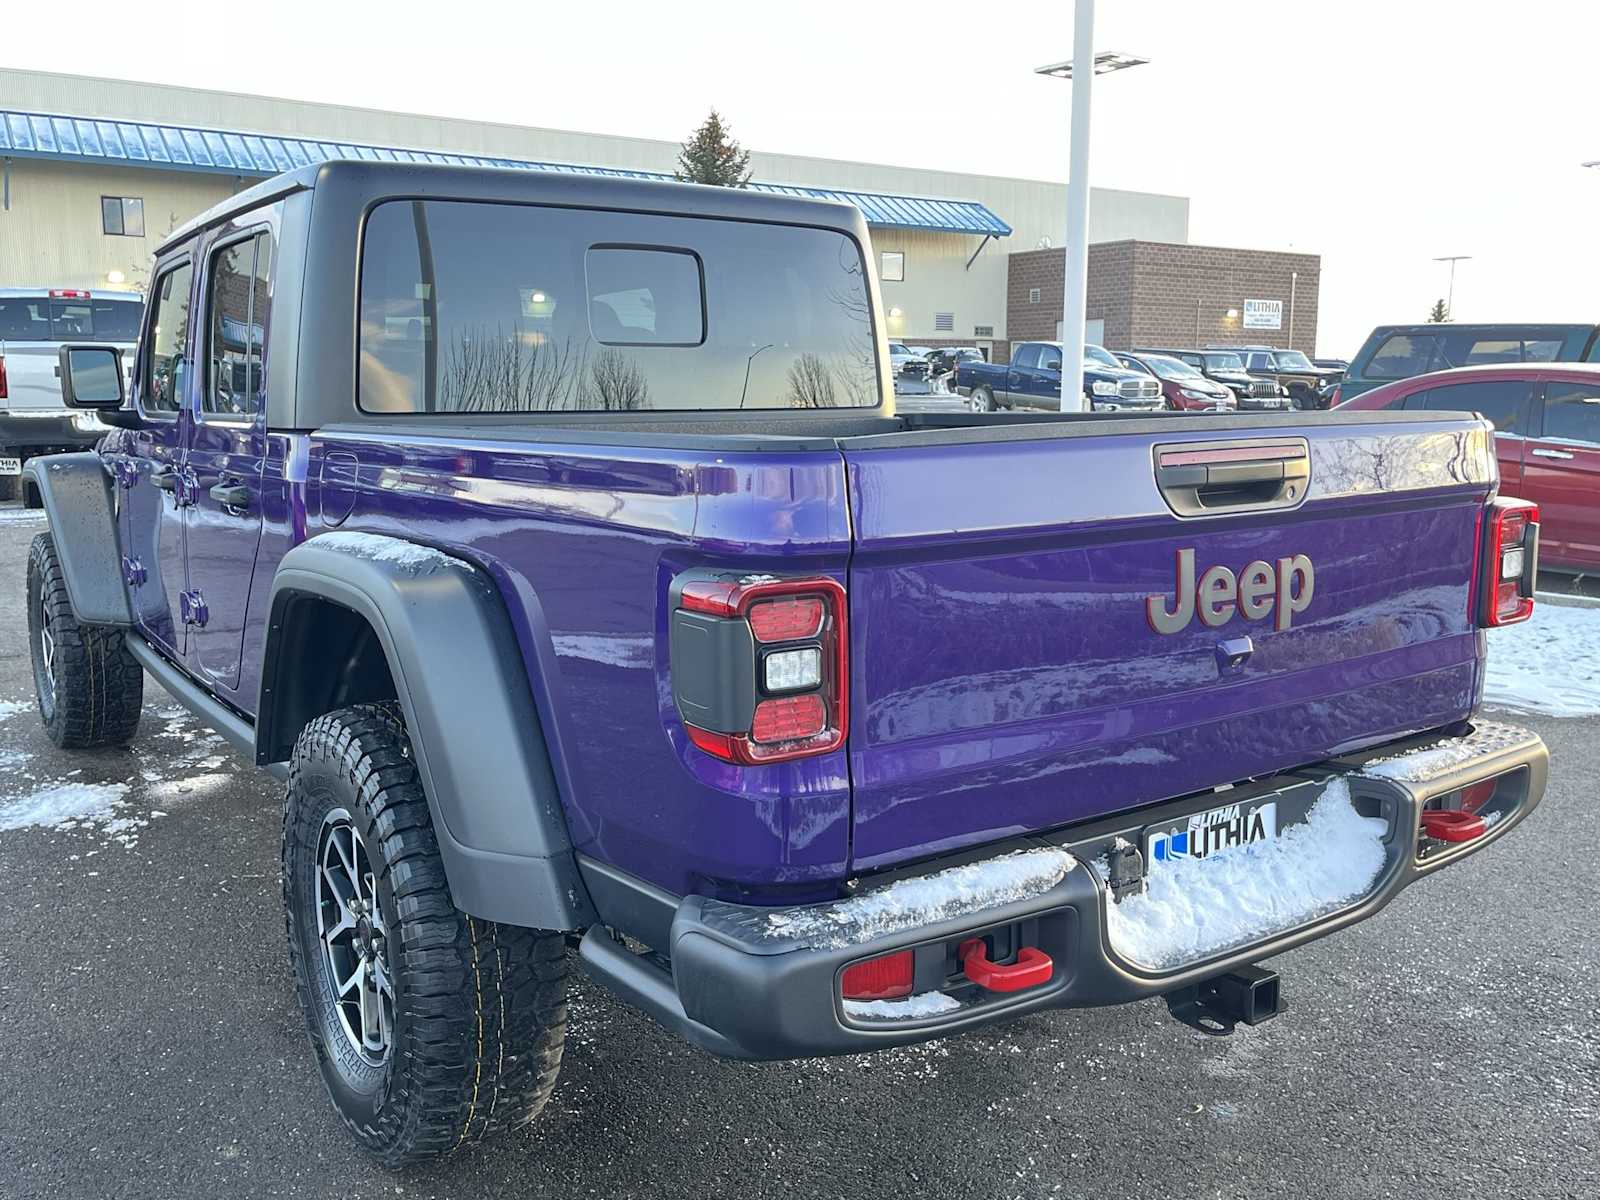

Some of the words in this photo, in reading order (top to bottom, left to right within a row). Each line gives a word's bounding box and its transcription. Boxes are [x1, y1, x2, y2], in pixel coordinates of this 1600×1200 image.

[1253, 301, 1280, 312] LITHIA
[1146, 548, 1315, 635] Jeep
[1200, 804, 1241, 829] LITHIA
[1189, 812, 1266, 859] LITHIA
